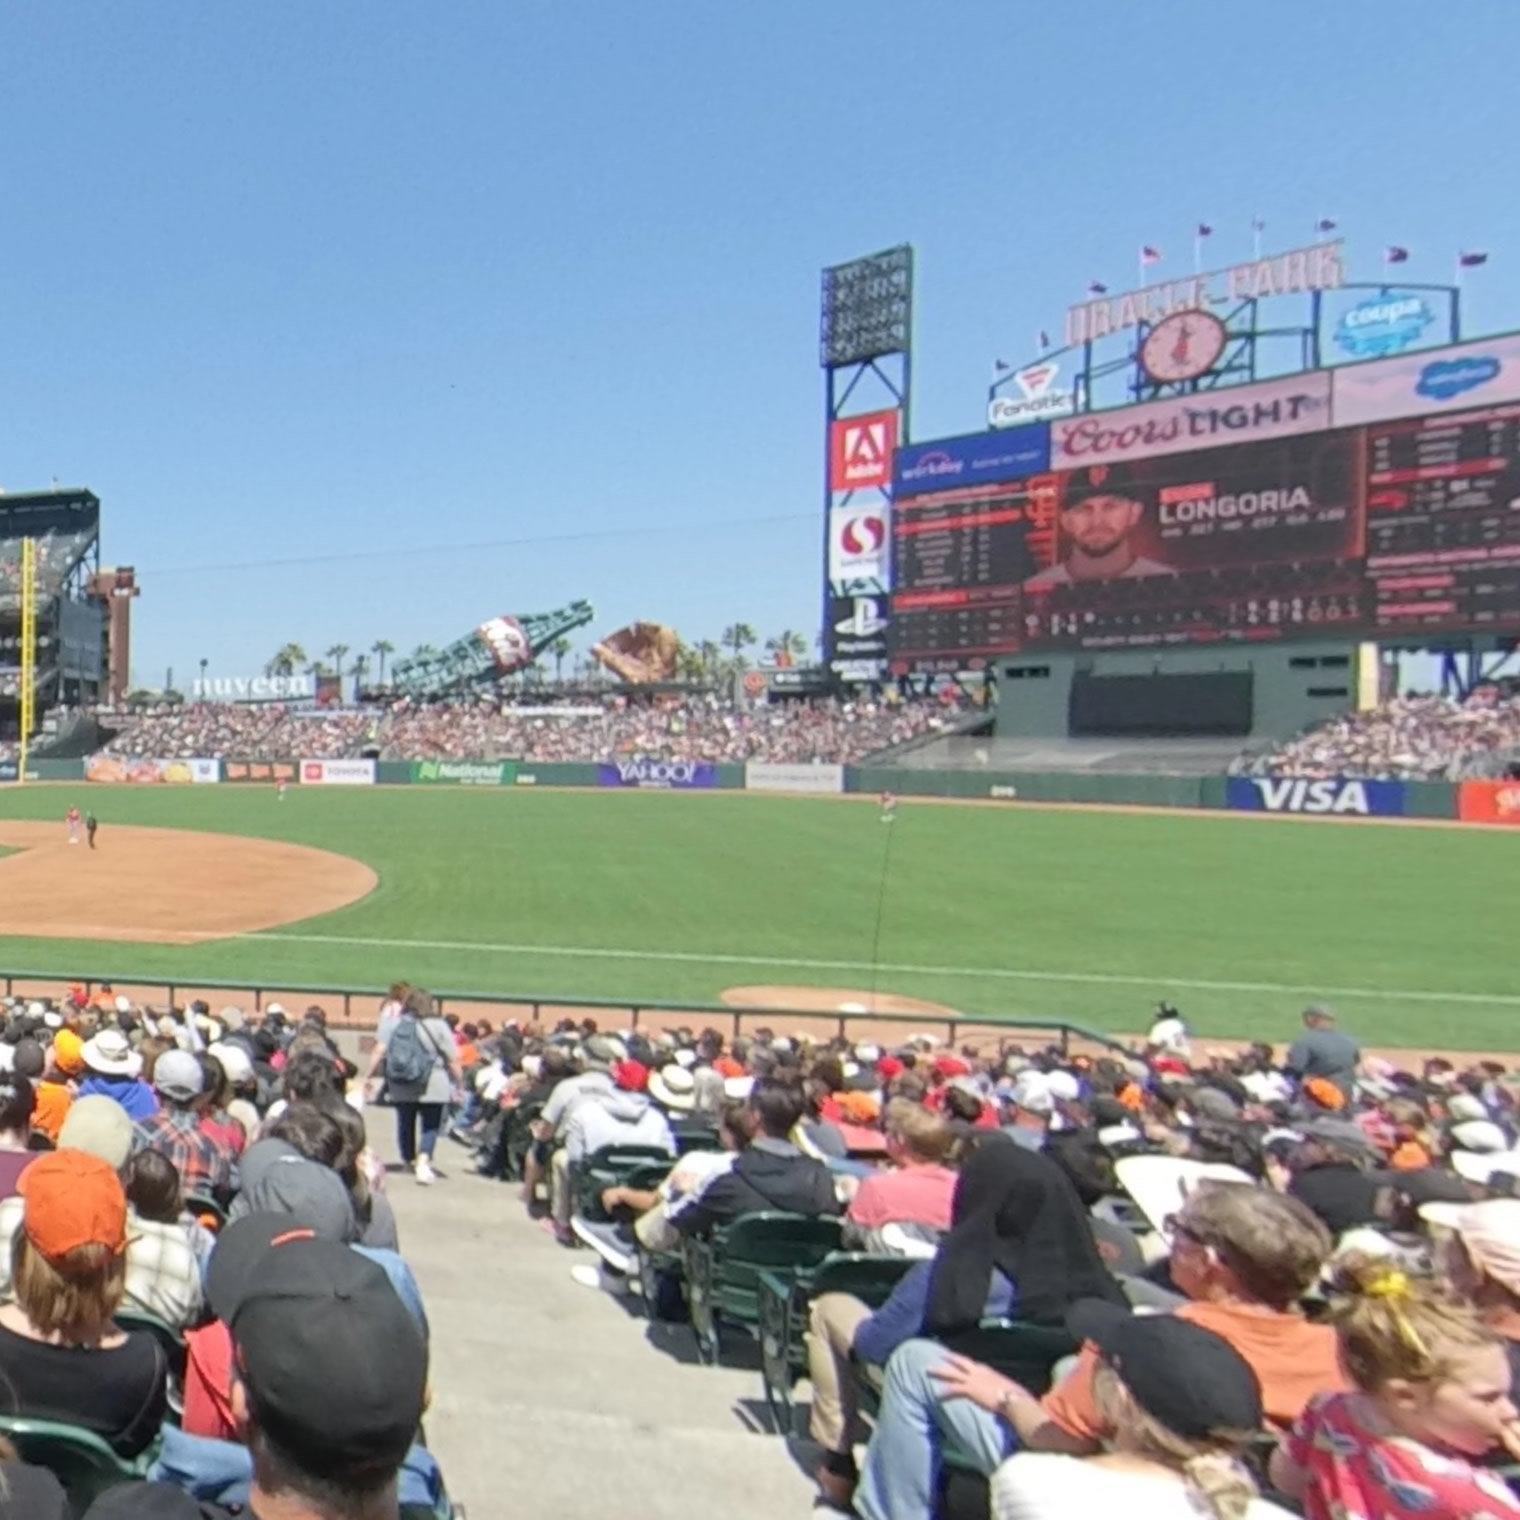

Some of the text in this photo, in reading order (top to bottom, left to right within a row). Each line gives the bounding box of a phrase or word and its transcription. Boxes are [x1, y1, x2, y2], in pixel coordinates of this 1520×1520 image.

[1228, 244, 1343, 302] PARK
[1346, 299, 1420, 325] coupa
[1062, 394, 1307, 457] Coors LIGHT
[1159, 485, 1311, 525] LONGORIA
[193, 676, 309, 696] nuveen
[438, 762, 505, 779] National
[616, 761, 696, 783] YAHOO!
[1252, 779, 1368, 814] VISA
